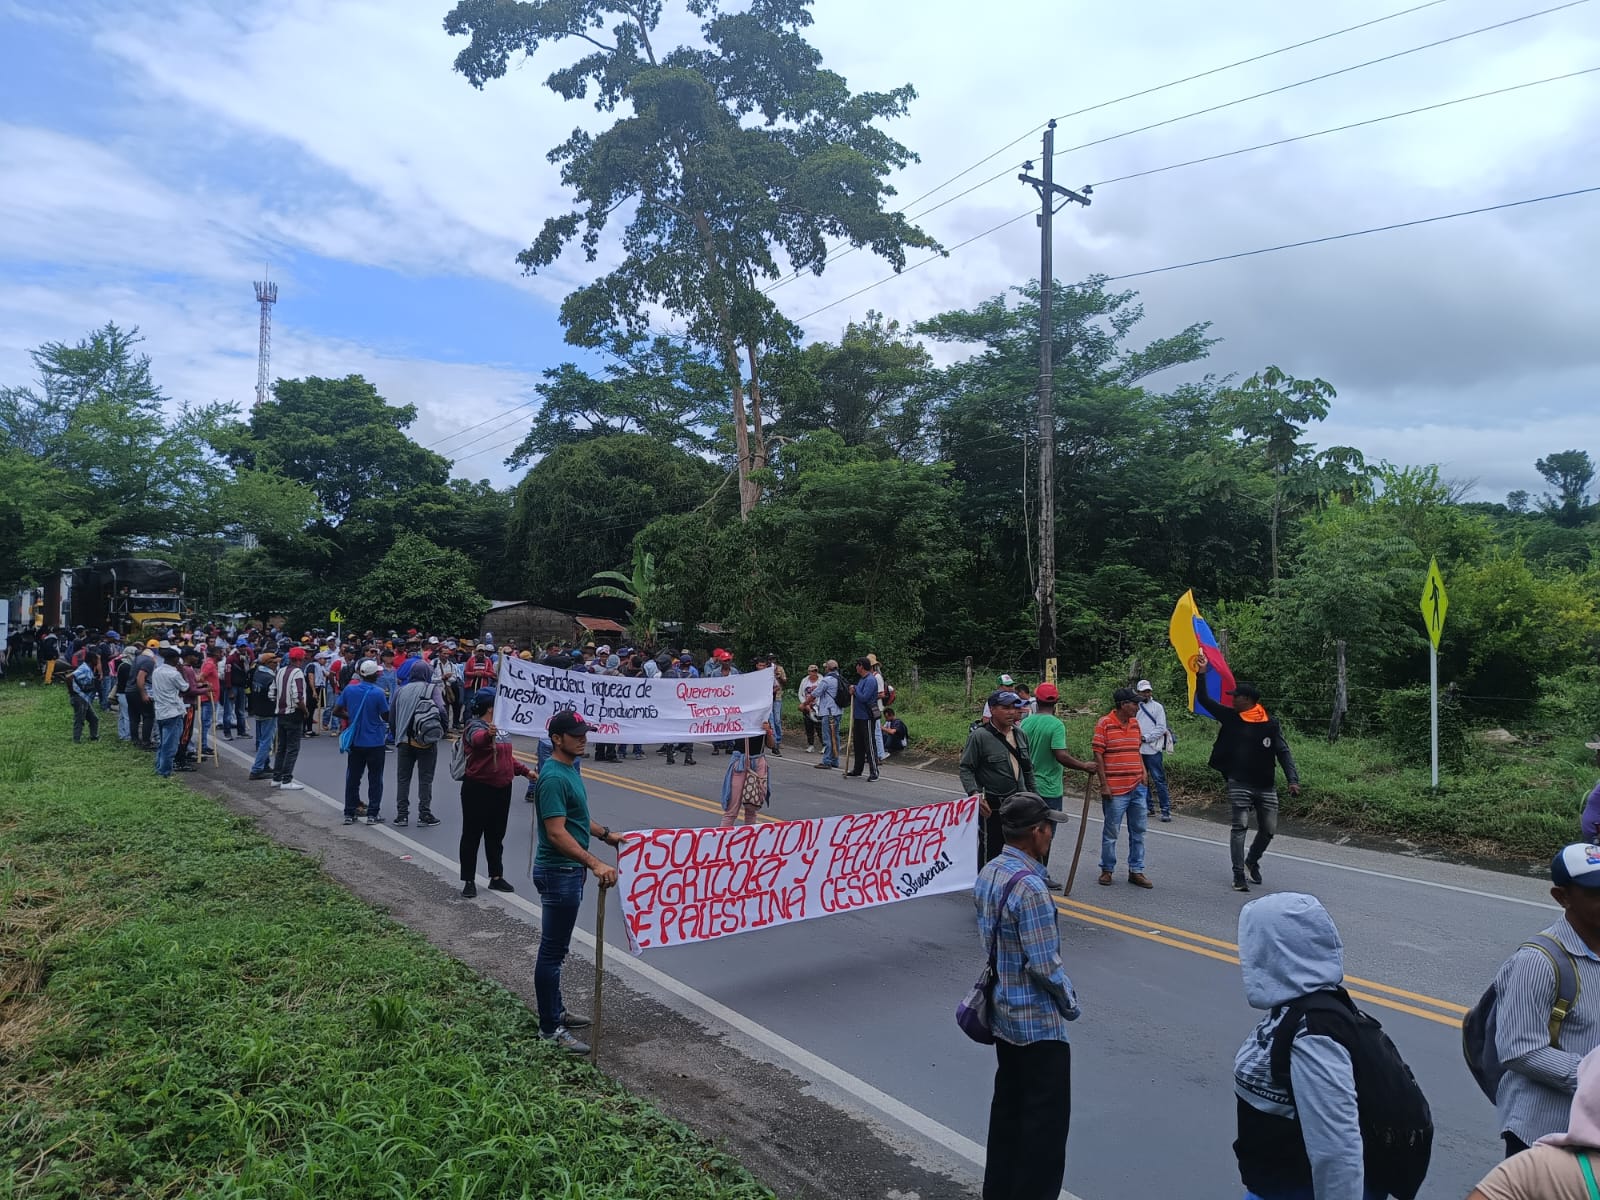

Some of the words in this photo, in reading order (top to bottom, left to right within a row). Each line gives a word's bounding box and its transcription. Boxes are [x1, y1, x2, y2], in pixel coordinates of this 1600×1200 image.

[499, 683, 547, 706] nuestro
[583, 697, 594, 717] la
[598, 699, 659, 723] producimos
[531, 667, 586, 694] verdadera
[591, 682, 632, 702] riqueza
[635, 680, 653, 698] de
[676, 682, 736, 702] Queremos:
[511, 703, 534, 725] los
[723, 706, 742, 721] para
[617, 817, 824, 875] ASOCIACION
[830, 795, 979, 848] CAMPESINA
[627, 856, 786, 912] AGRICOLA
[827, 829, 947, 879] PECUARIA
[659, 883, 806, 945] PALESTINA
